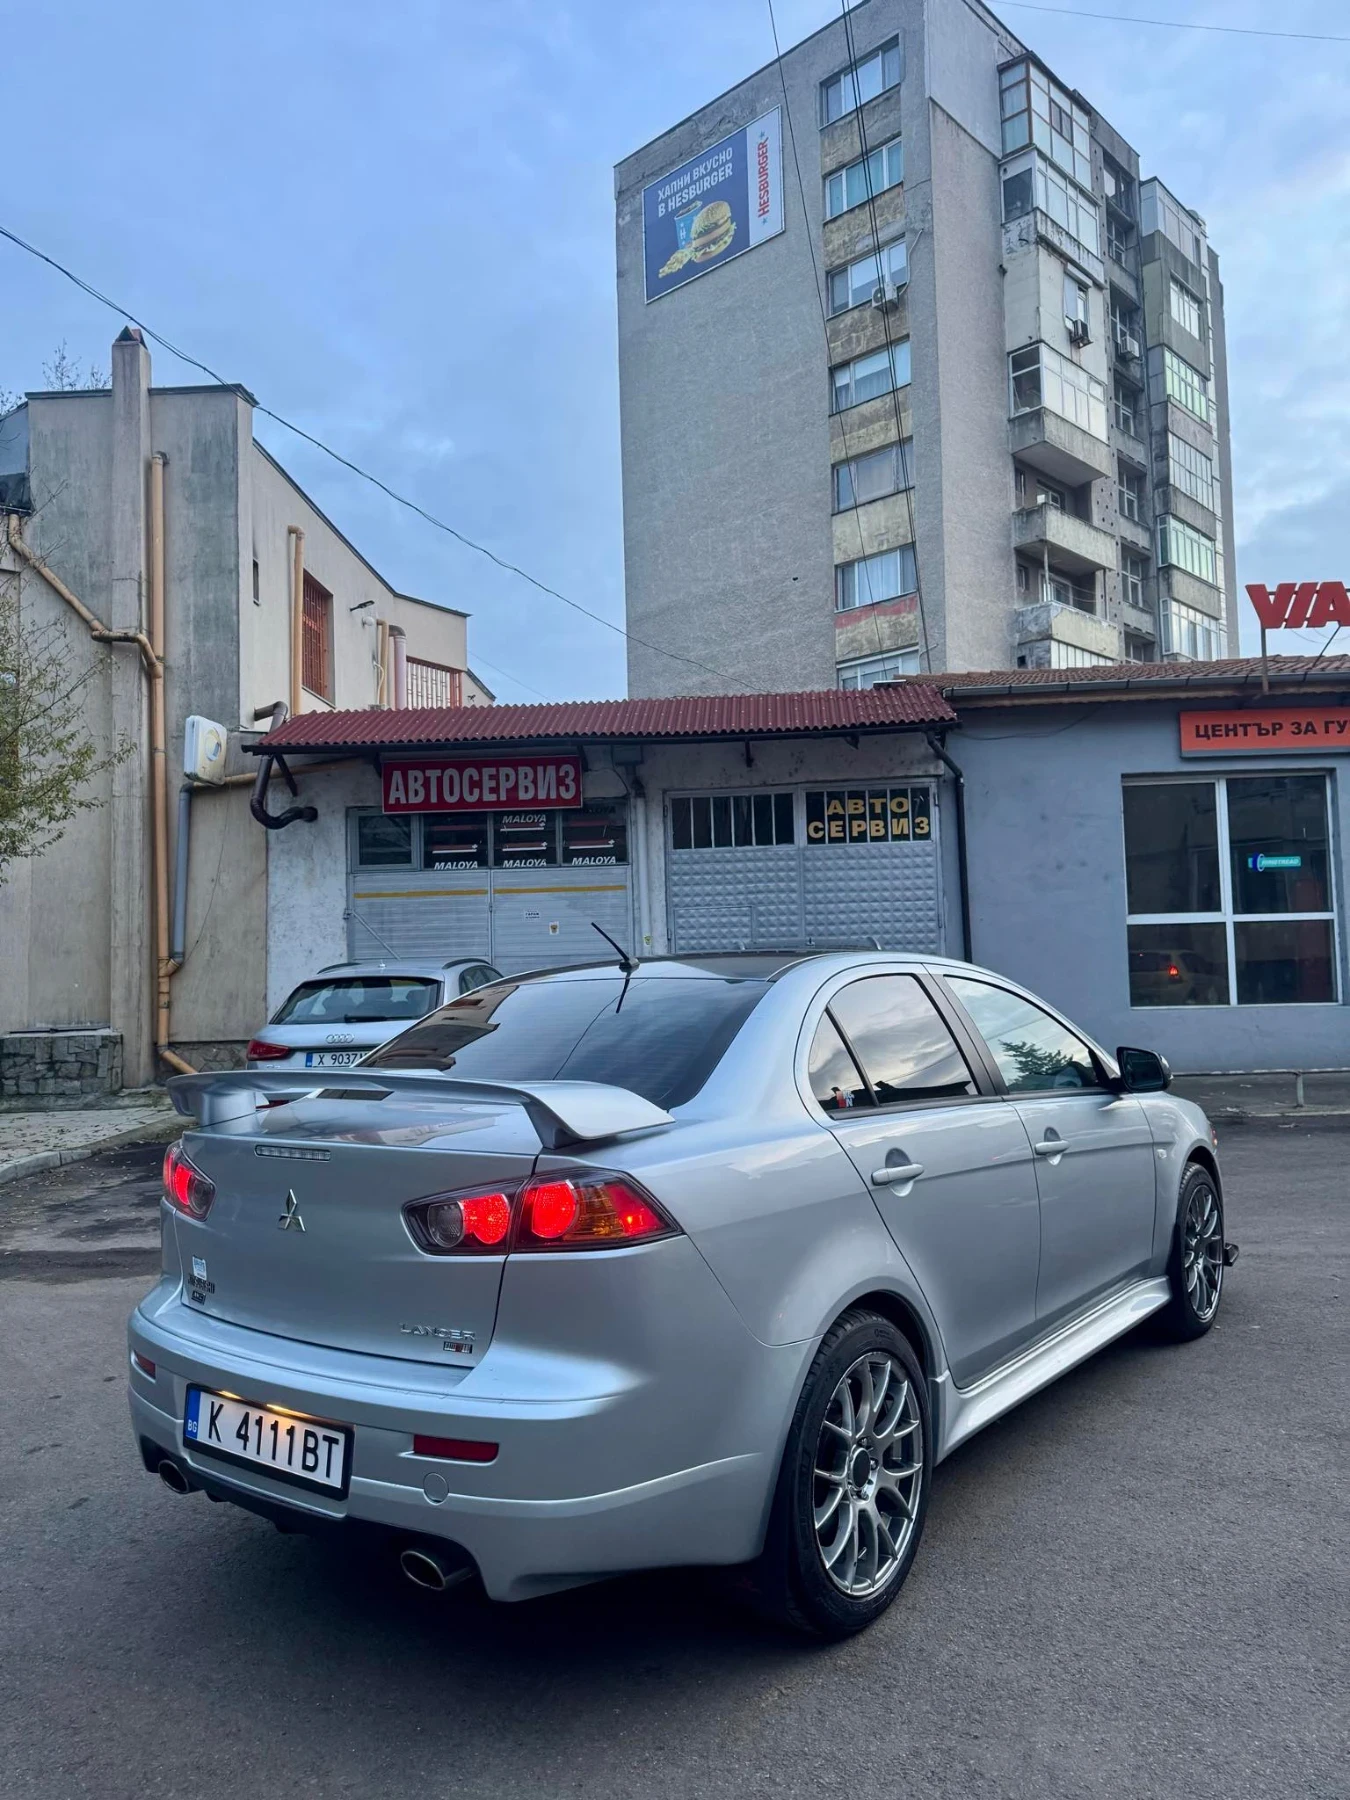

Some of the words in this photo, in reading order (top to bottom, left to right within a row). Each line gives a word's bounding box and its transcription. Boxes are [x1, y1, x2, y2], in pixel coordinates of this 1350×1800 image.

[658, 174, 691, 202] ХАПНИ
[692, 147, 733, 180] ВКУСНО
[757, 136, 770, 219] HESBURGER
[668, 163, 733, 212] HESBURGER
[1195, 722, 1283, 740] ЦЕНТЪР
[1290, 721, 1317, 736] ЗА
[388, 764, 576, 804] АВТОСЕРВИЗ
[827, 798, 909, 815] АВТО
[502, 814, 547, 824] MALOYA
[808, 816, 930, 838] СЕРВИЗ
[434, 861, 478, 870] MALOYA
[502, 859, 547, 868] MALOYA
[571, 856, 616, 866] MALOYA
[401, 1323, 477, 1341] LANCER
[187, 1419, 198, 1433] BG
[208, 1400, 224, 1443] K
[235, 1411, 340, 1478] 4111BT
